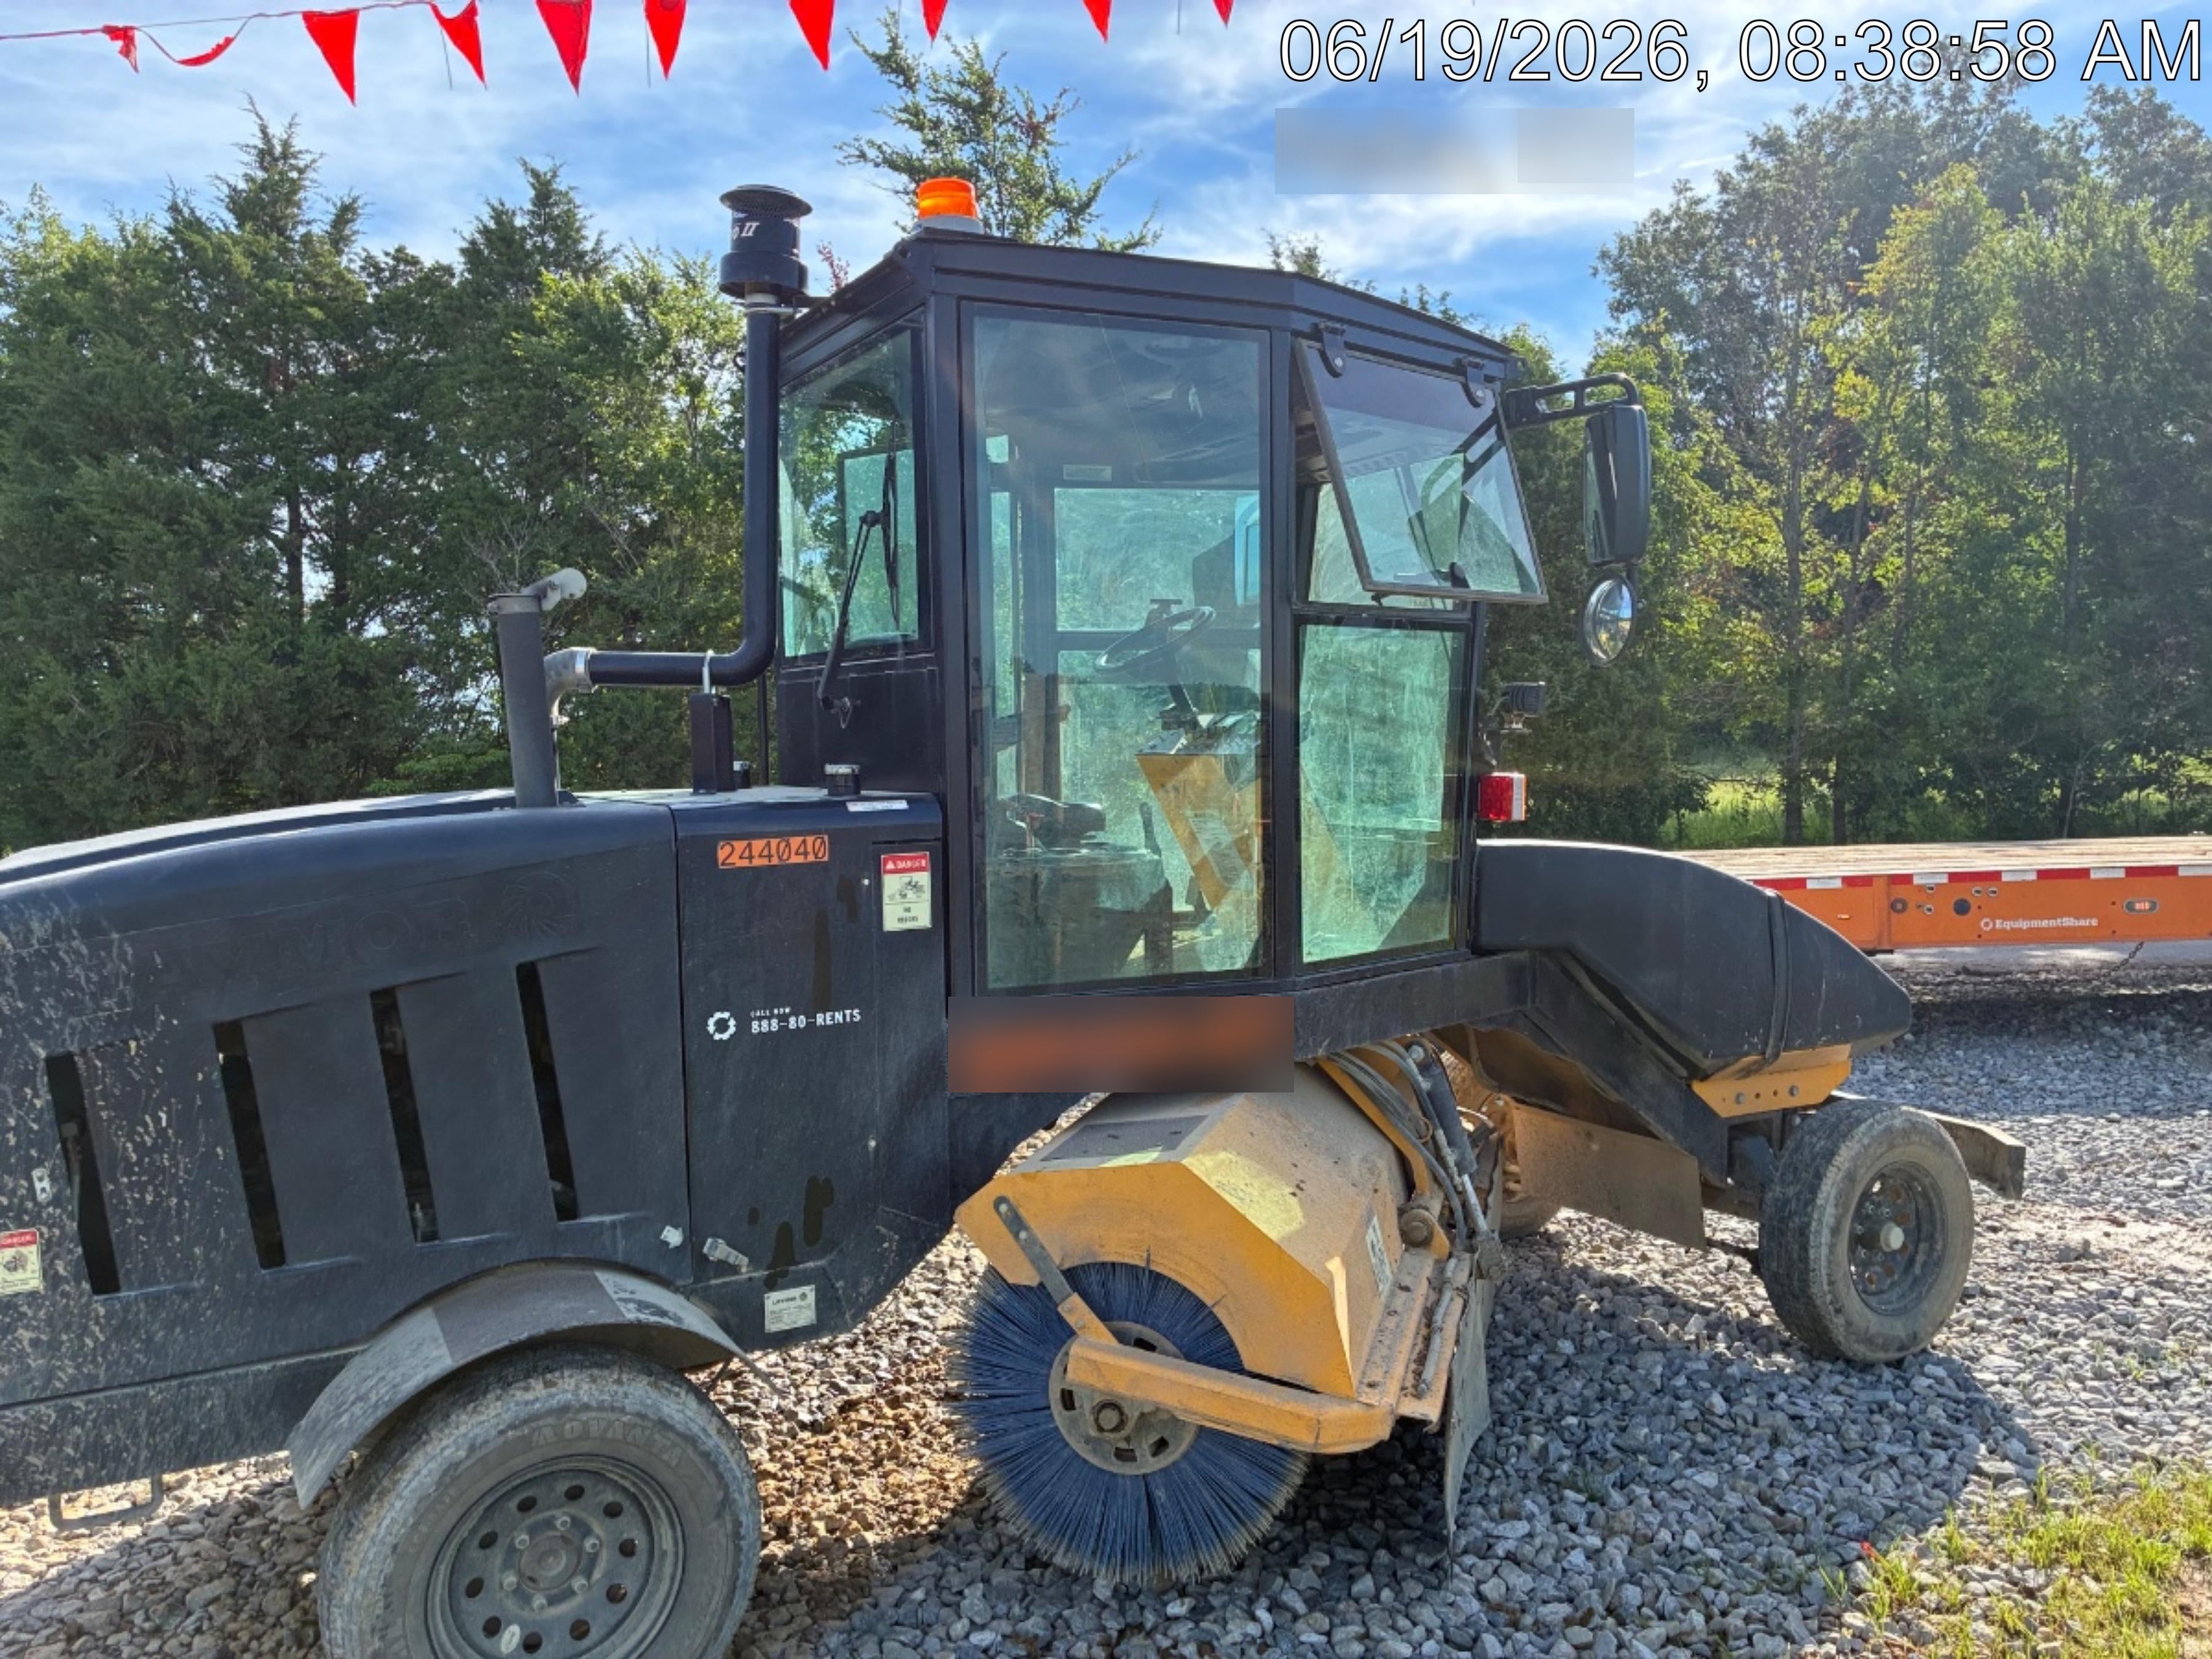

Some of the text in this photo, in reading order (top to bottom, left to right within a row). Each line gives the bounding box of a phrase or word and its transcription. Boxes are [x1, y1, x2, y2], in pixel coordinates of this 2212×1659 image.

[720, 836, 827, 866] 244040
[1995, 917, 2098, 930] EquipmentShare
[751, 1008, 861, 1034] 888-80-RENTS
